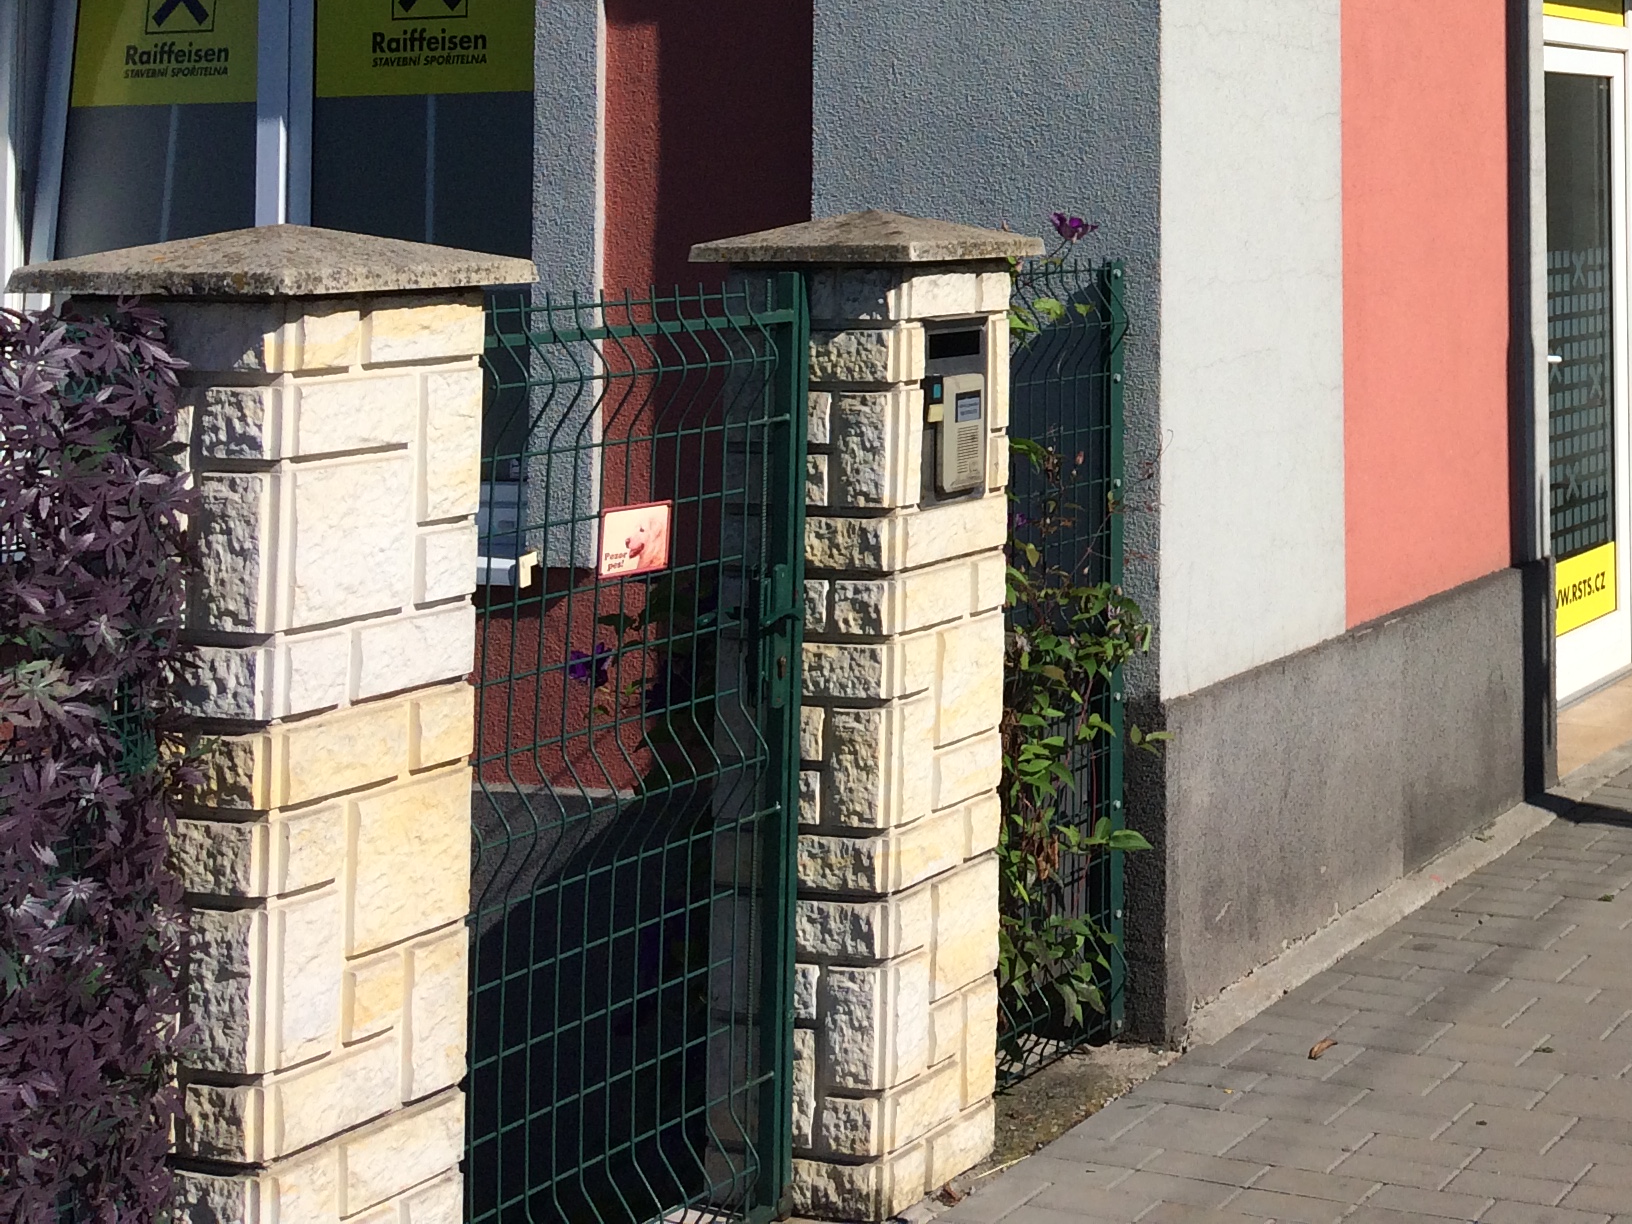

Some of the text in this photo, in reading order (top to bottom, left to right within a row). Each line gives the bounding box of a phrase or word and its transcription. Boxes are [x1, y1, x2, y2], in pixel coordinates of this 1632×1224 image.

[371, 28, 488, 54] Raiffeisen
[125, 42, 229, 65] Raiffeisen
[372, 52, 488, 68] STAVEBNÍ SPOŘITELNA
[123, 64, 229, 79] STAVEBNÍ SPOŘITELNA
[604, 552, 628, 560] Pozor
[1556, 570, 1606, 610] W.RSTS.CZ
